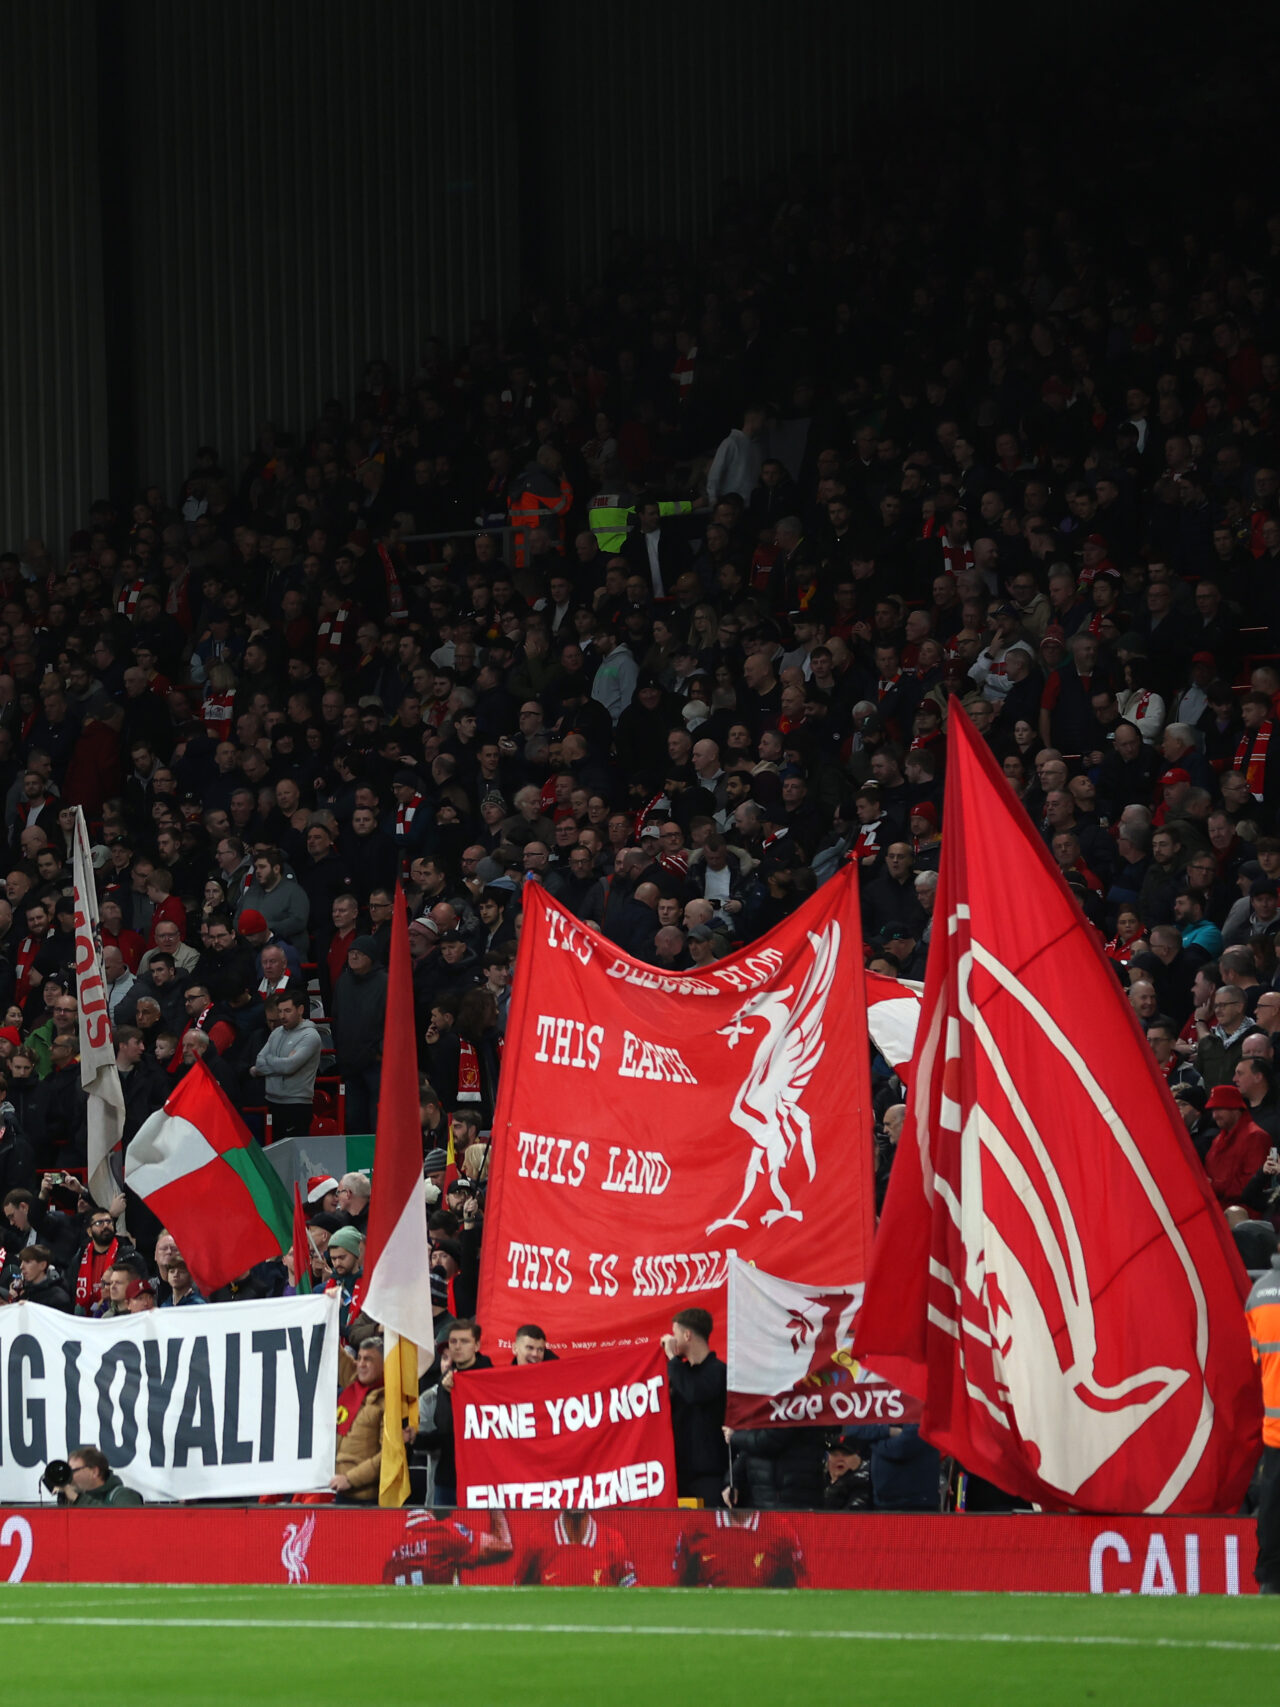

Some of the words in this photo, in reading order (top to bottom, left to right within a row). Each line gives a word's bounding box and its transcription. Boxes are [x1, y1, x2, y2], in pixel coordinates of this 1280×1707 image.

[534, 1014, 605, 1071] THIS
[618, 1030, 698, 1085] EARTH
[517, 1132, 589, 1188] THIS
[601, 1146, 672, 1196] LAND
[507, 1241, 571, 1294] THIS
[588, 1252, 620, 1297] IS
[62, 1323, 326, 1468] LOYALTY
[463, 1401, 536, 1440] ARNE
[547, 1390, 603, 1436] YOU
[608, 1374, 665, 1424] NOT
[829, 1389, 905, 1420] OUTS
[466, 1459, 665, 1509] ENTERTAINED
